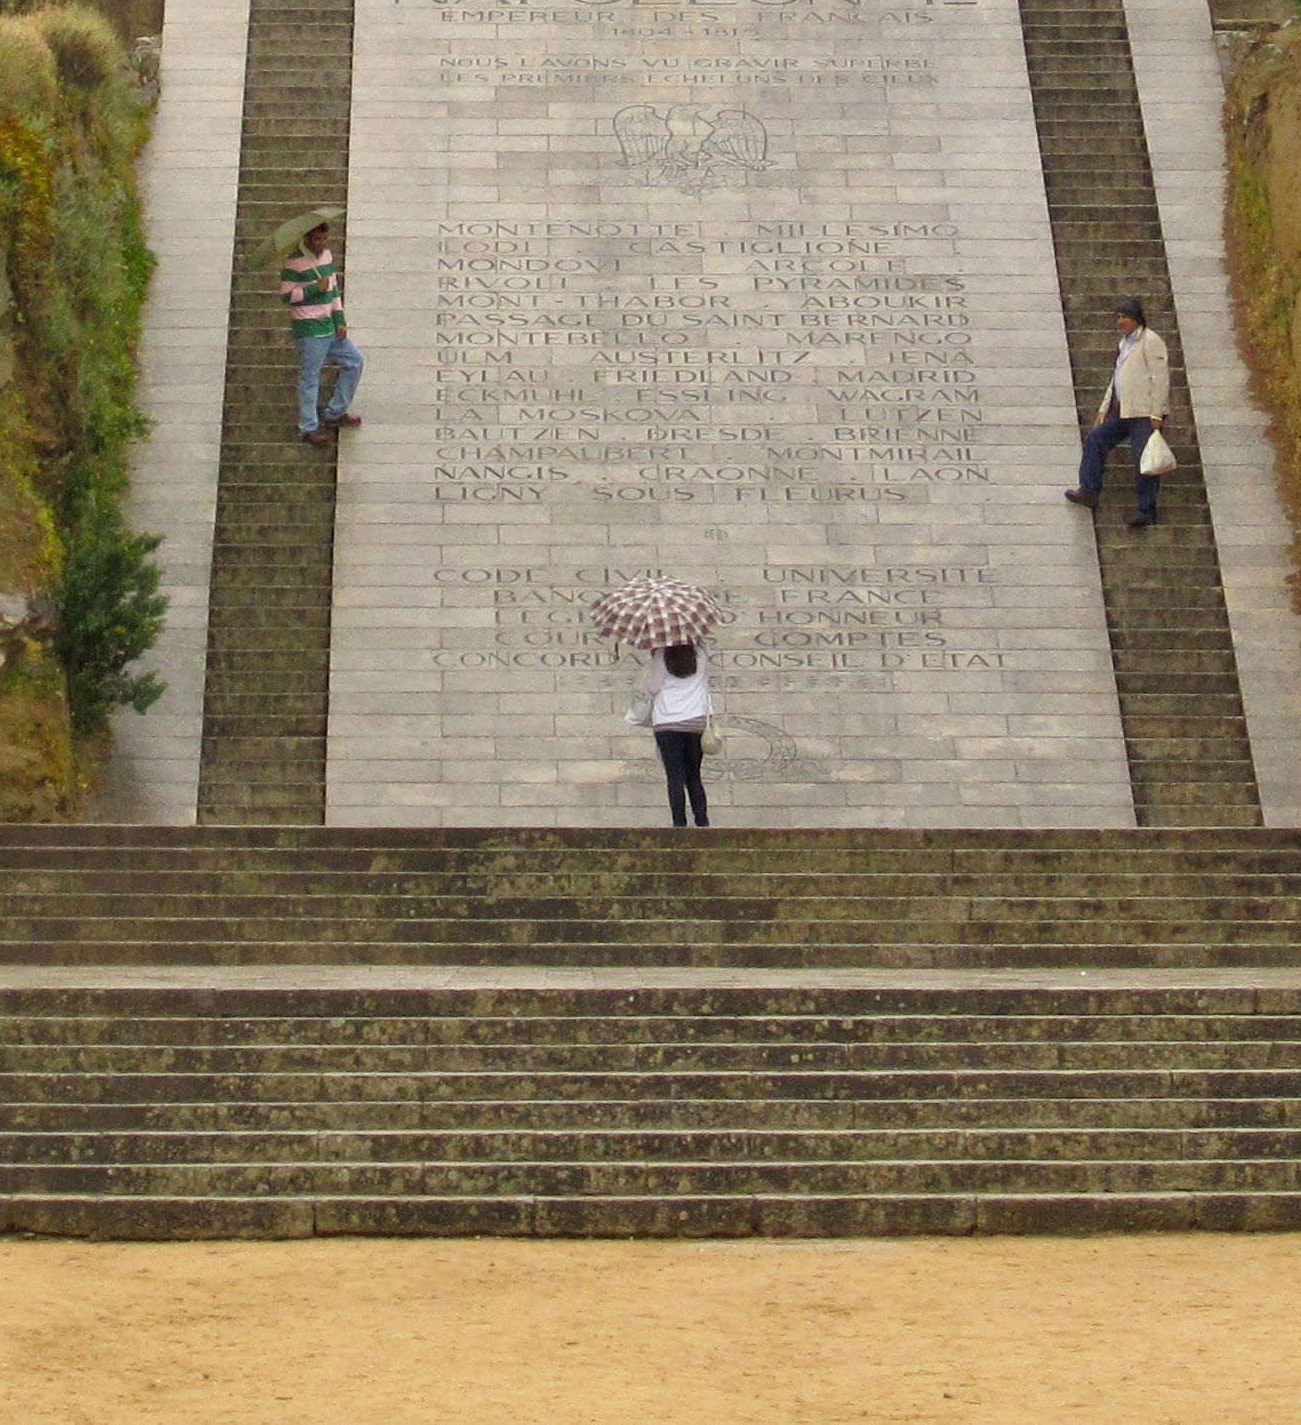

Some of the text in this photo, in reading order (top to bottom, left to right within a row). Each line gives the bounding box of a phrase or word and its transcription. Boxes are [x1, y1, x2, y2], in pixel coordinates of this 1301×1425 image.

[440, 11, 934, 23] EMPEREUR DES FRANCAIS
[440, 57, 937, 69] NOUS L'AVONS VU GRAVIR SUPERBE
[440, 72, 488, 83] LES
[501, 72, 635, 83] PREMIERS
[799, 72, 849, 84] DES
[863, 72, 940, 84] CIEUX
[438, 224, 959, 236] MONTENOTTE MILLESIMO
[438, 241, 896, 253] LODI CASTIGLIONE
[437, 258, 905, 272] MONDOVI ARCOLE
[438, 276, 965, 290] RIVOLI LES PYRAMIDES
[801, 295, 969, 308] ABOUKIR
[436, 313, 970, 326] PASSAGE DU SAINT BERNARD
[436, 331, 972, 345] MONTEBELLO MARENGO
[437, 350, 512, 364] ULM
[589, 351, 811, 364] AUSTERLITZ
[436, 369, 976, 383] EYLAU FRIEDLAND MADRID
[436, 389, 979, 402] ECKMUHL ESSLING WAGRAM
[436, 408, 983, 422] LA MOSKOVA LUTZEN
[435, 427, 983, 441] BAUTZEN DRESDE BRIENNE
[436, 446, 988, 460] CHAMPAUBERT MONTMIRAIL
[434, 466, 989, 481] NANGIS CRAONNE LAON
[435, 487, 906, 501] LIGNY SOUS FLEURUS
[434, 568, 542, 583] CODE
[762, 568, 1000, 583] UNIVERSITE
[781, 589, 945, 604] FRANCE
[495, 610, 586, 624] LEGI
[754, 632, 947, 647] COMPTES
[433, 652, 644, 667] CONCORDA
[708, 653, 865, 667] CONSEIL
